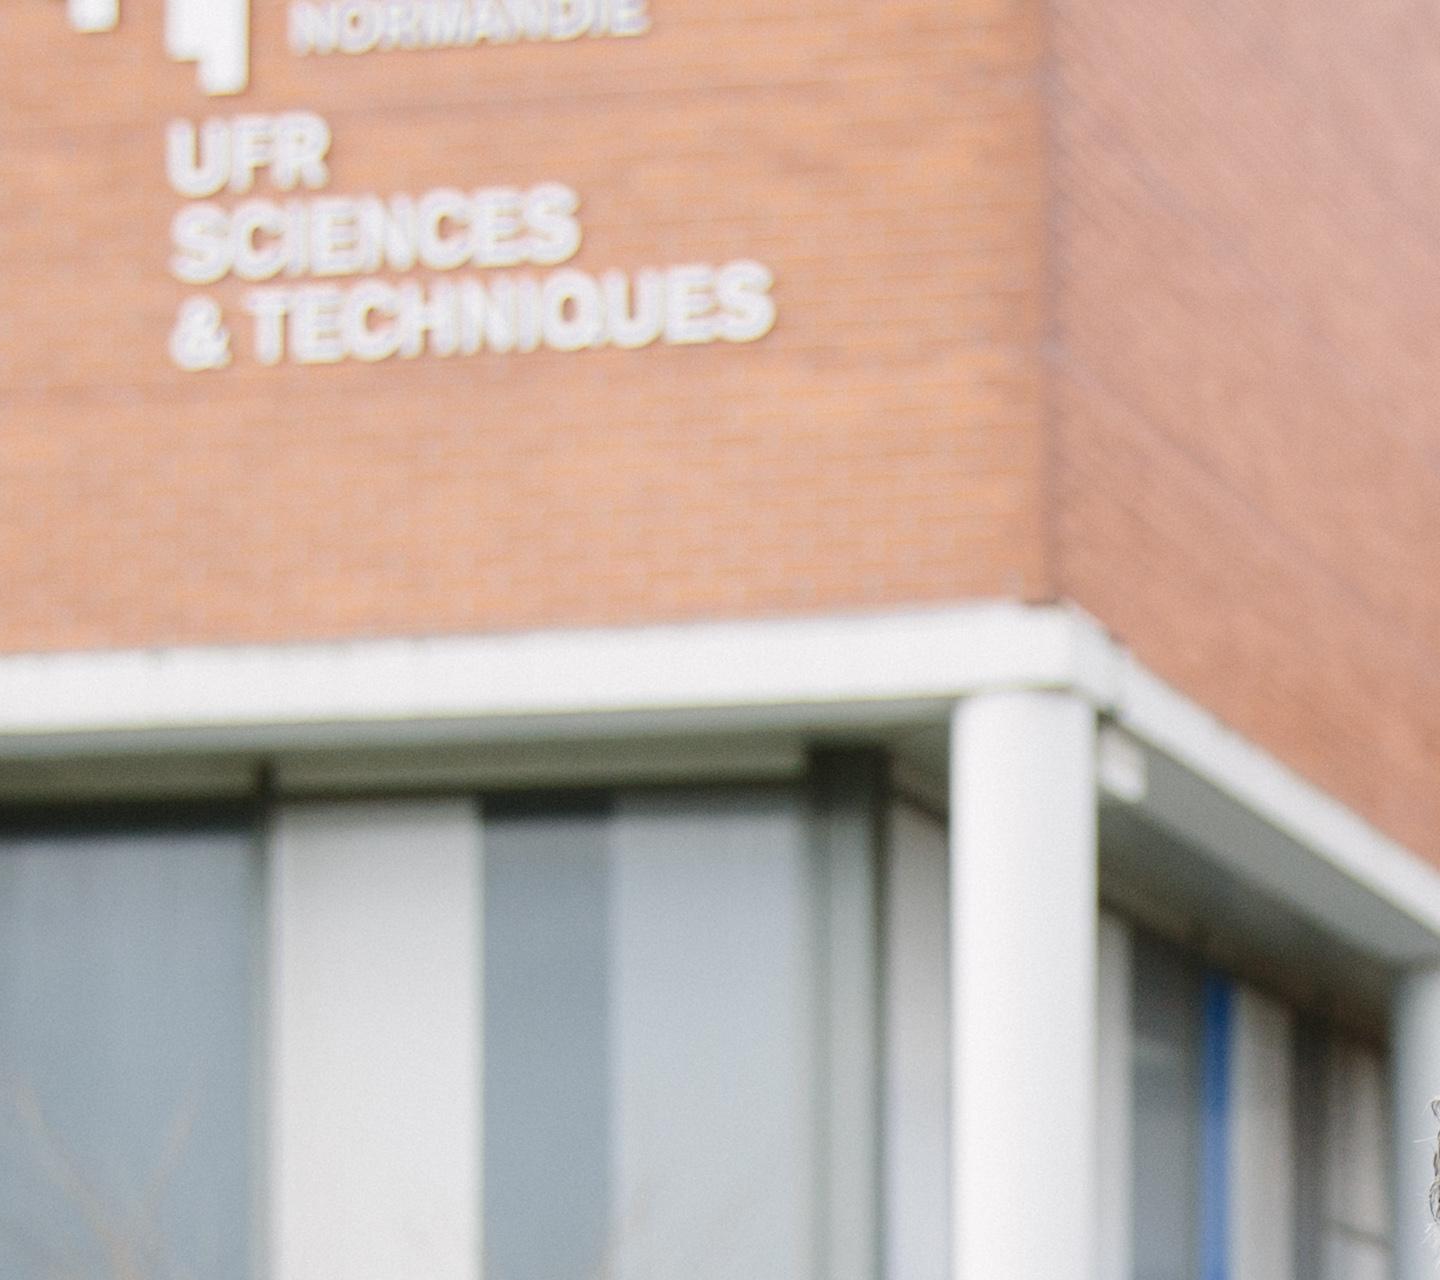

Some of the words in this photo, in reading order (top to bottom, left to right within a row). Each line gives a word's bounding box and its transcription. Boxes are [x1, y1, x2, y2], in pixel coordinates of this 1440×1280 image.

[169, 113, 329, 195] UFR
[173, 185, 580, 283] SCIENCES
[171, 297, 230, 370] &
[246, 261, 775, 363] TECHNIQUES
